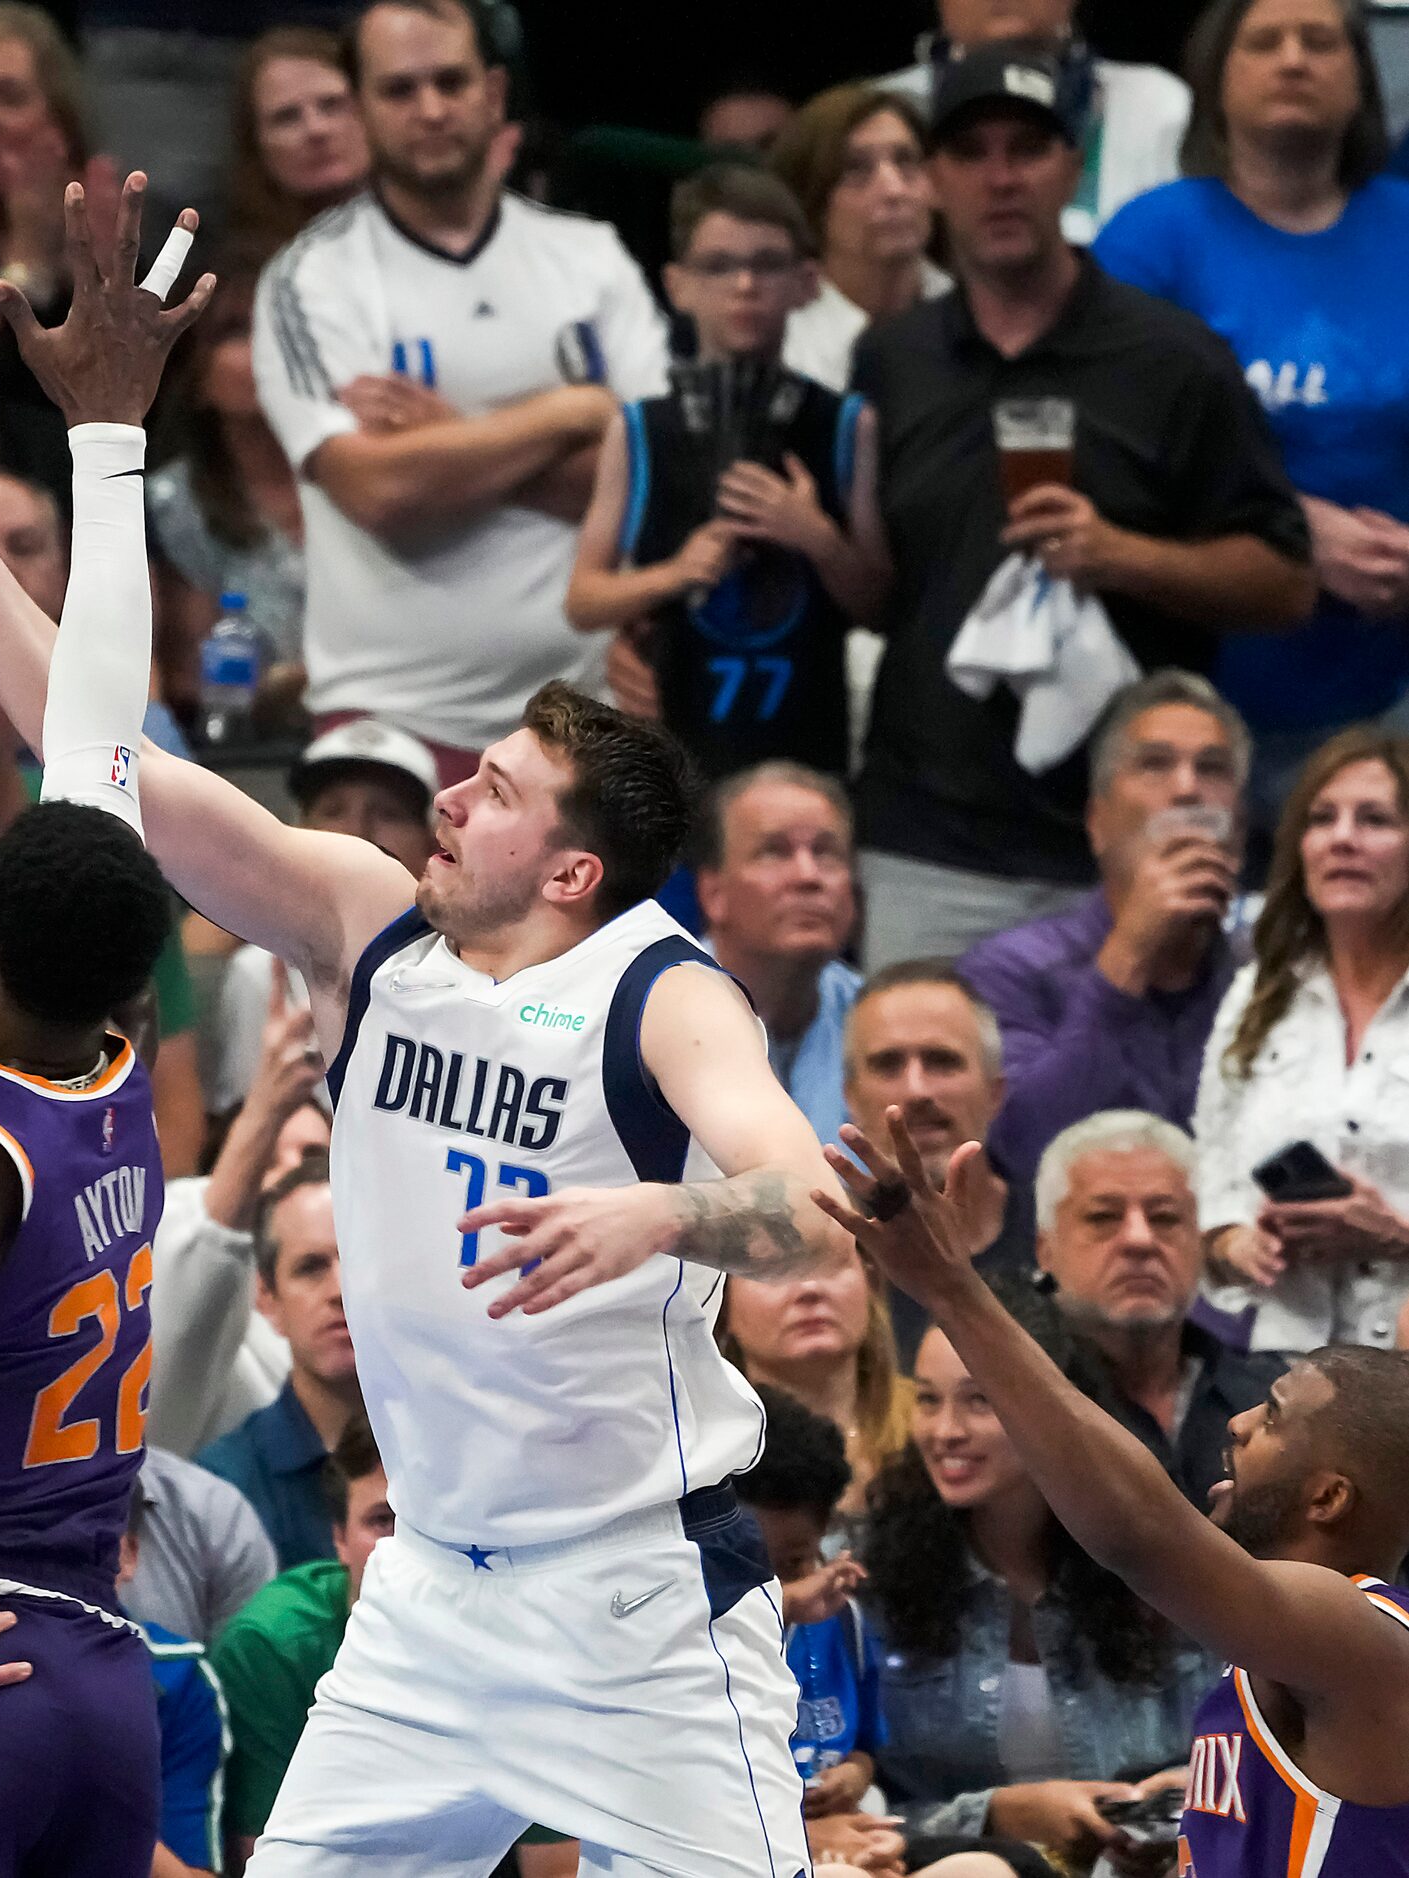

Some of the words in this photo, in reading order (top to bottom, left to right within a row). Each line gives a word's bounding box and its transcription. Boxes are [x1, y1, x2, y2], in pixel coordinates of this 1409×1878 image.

[709, 656, 793, 721] 77
[519, 1003, 585, 1031] chime
[371, 1031, 571, 1153] DALLAS
